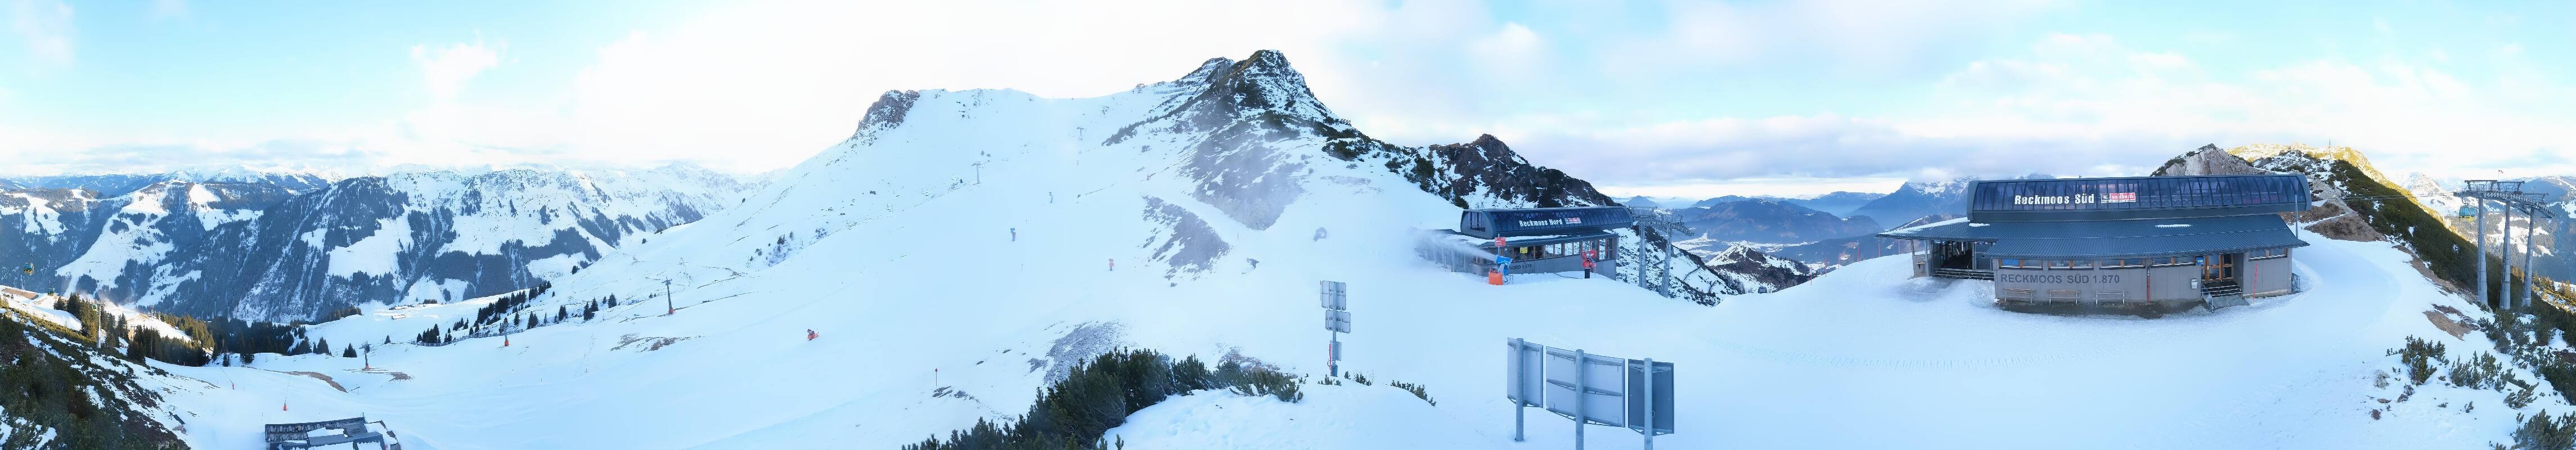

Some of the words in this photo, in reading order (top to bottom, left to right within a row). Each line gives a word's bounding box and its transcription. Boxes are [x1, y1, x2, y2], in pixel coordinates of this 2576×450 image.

[2014, 195, 2070, 205] Reckmoos
[2074, 193, 2094, 204] Süd
[2000, 274, 2062, 284] RECKMOOS
[2067, 273, 2089, 284] SÜD
[2093, 274, 2120, 284] 1.870
